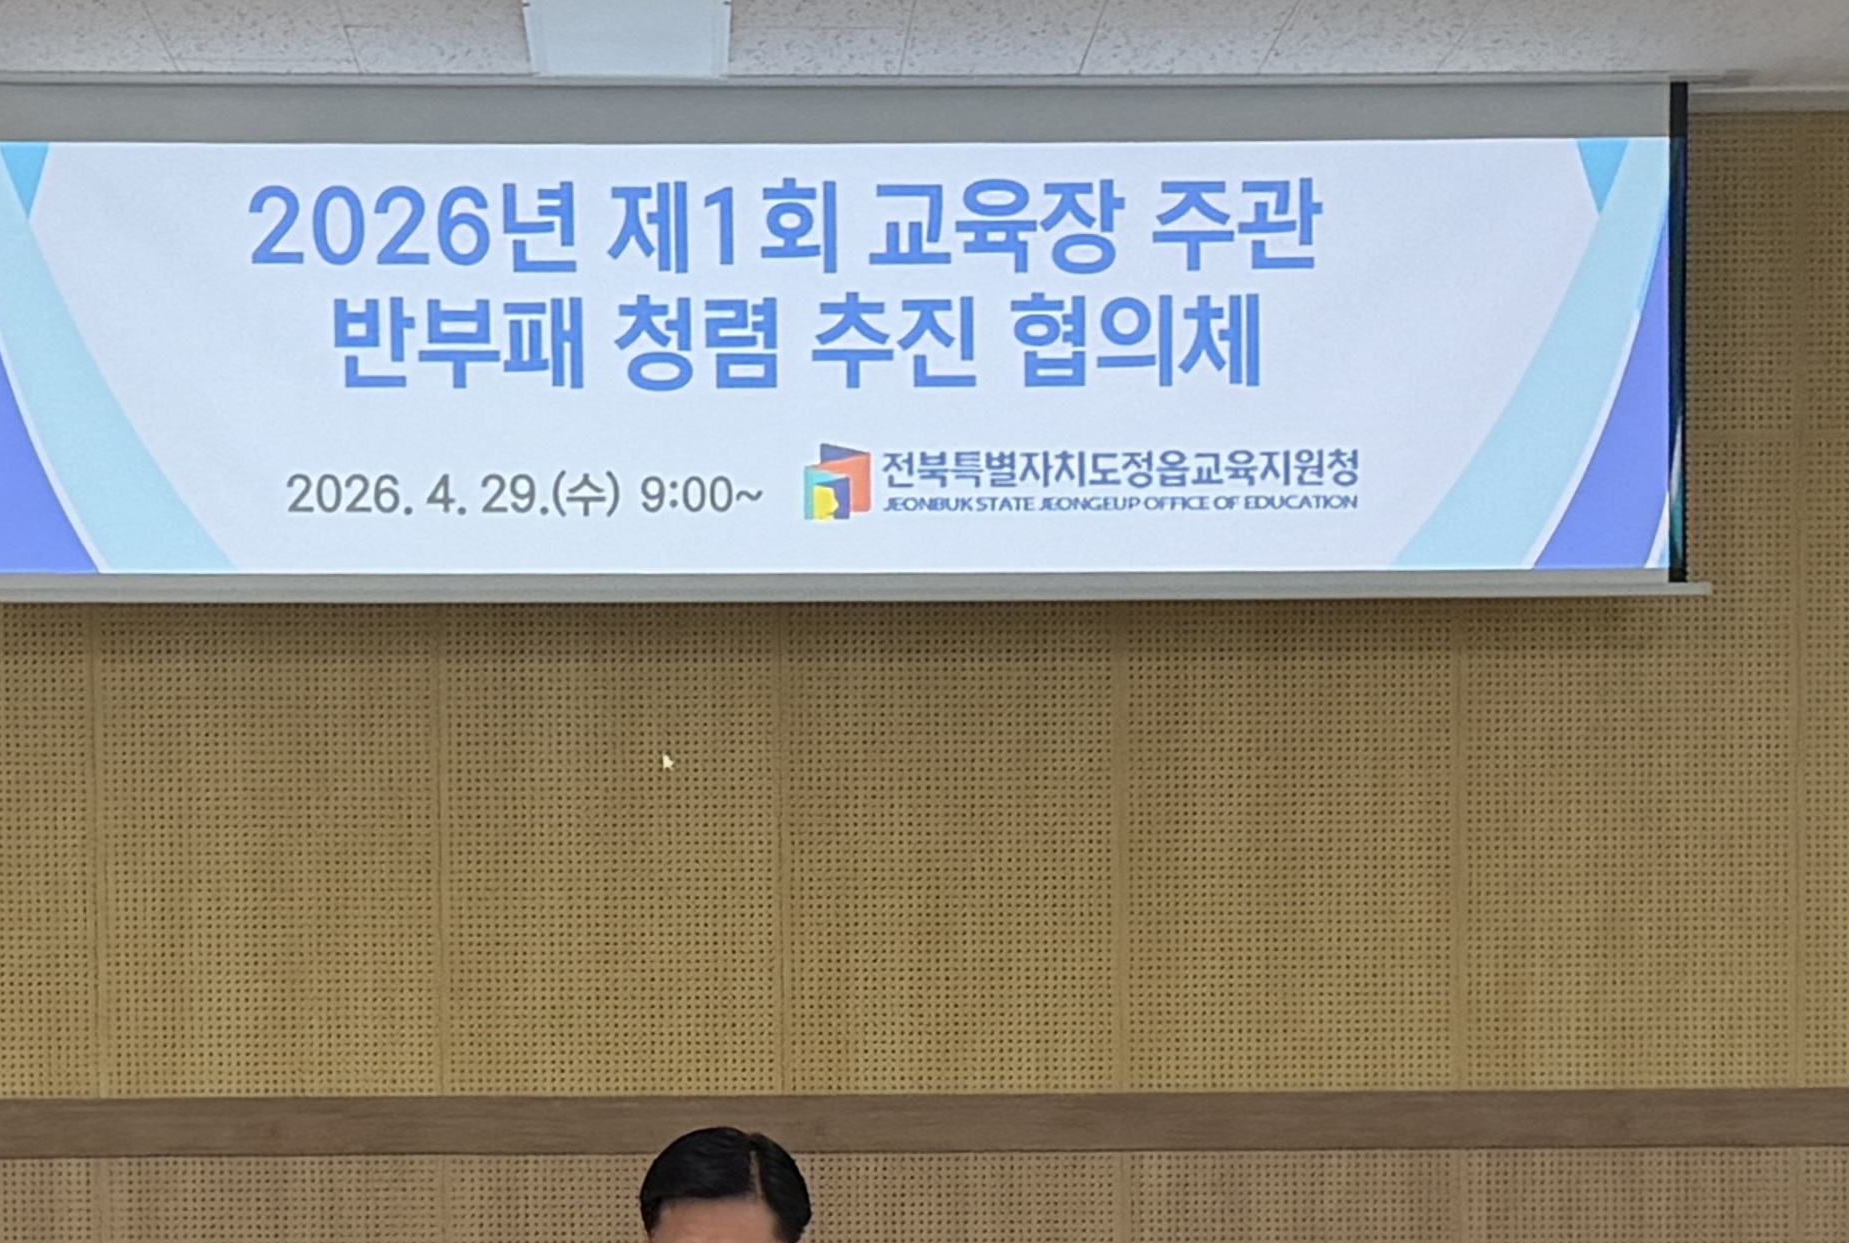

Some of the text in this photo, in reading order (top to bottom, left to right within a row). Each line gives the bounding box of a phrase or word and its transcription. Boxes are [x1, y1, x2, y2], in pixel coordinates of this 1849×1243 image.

[248, 177, 1324, 275] 2026년 제1회 교육장 주관
[333, 291, 1261, 392] 반부패 청렴 추진 협의체
[882, 448, 1359, 489] 전북특별자치도정읍교육지원청
[286, 470, 764, 517] 2026. 4. 29.(수) 9:00~
[883, 494, 1359, 512] JEONBUK STATE JEONGEUP OFFICE OF EDUCATION
